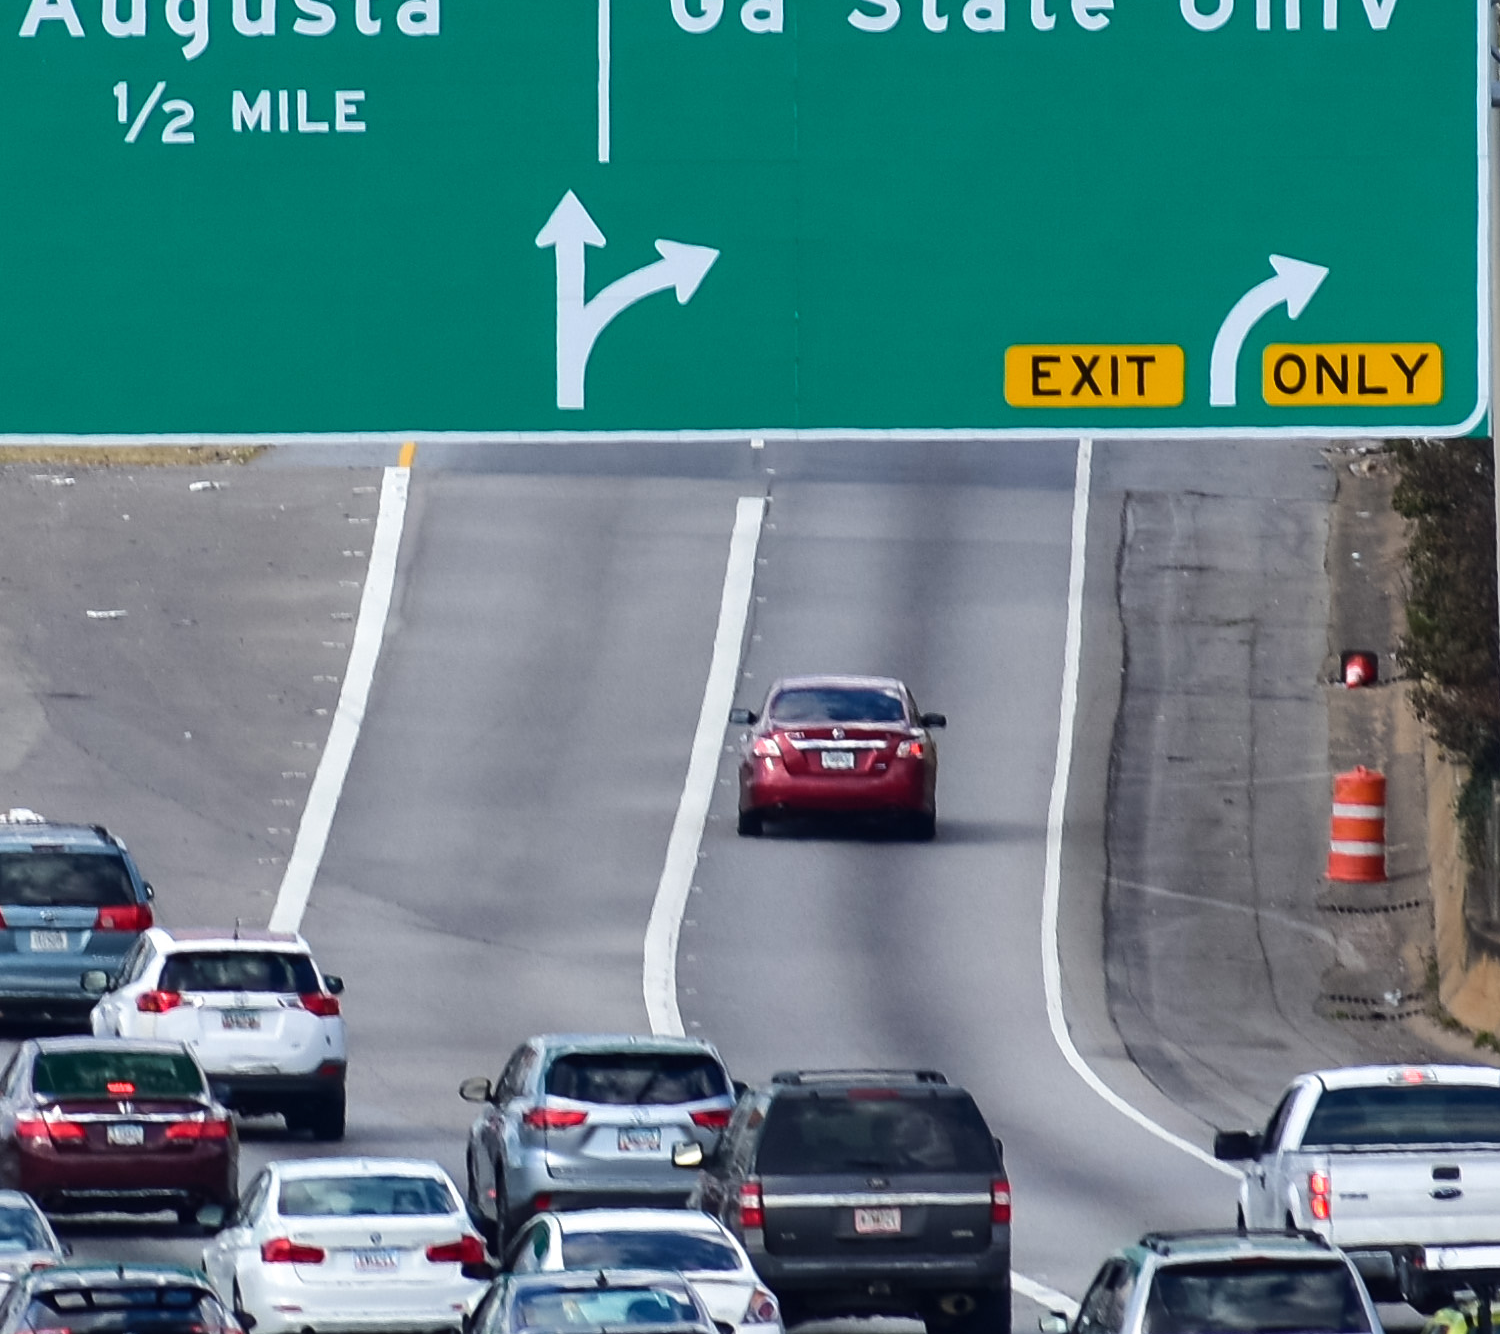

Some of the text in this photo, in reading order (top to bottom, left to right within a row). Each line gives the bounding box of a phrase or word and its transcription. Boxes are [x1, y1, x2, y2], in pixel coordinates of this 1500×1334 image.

[231, 88, 369, 135] MILE
[1030, 352, 1430, 399] EXIT ONLY
